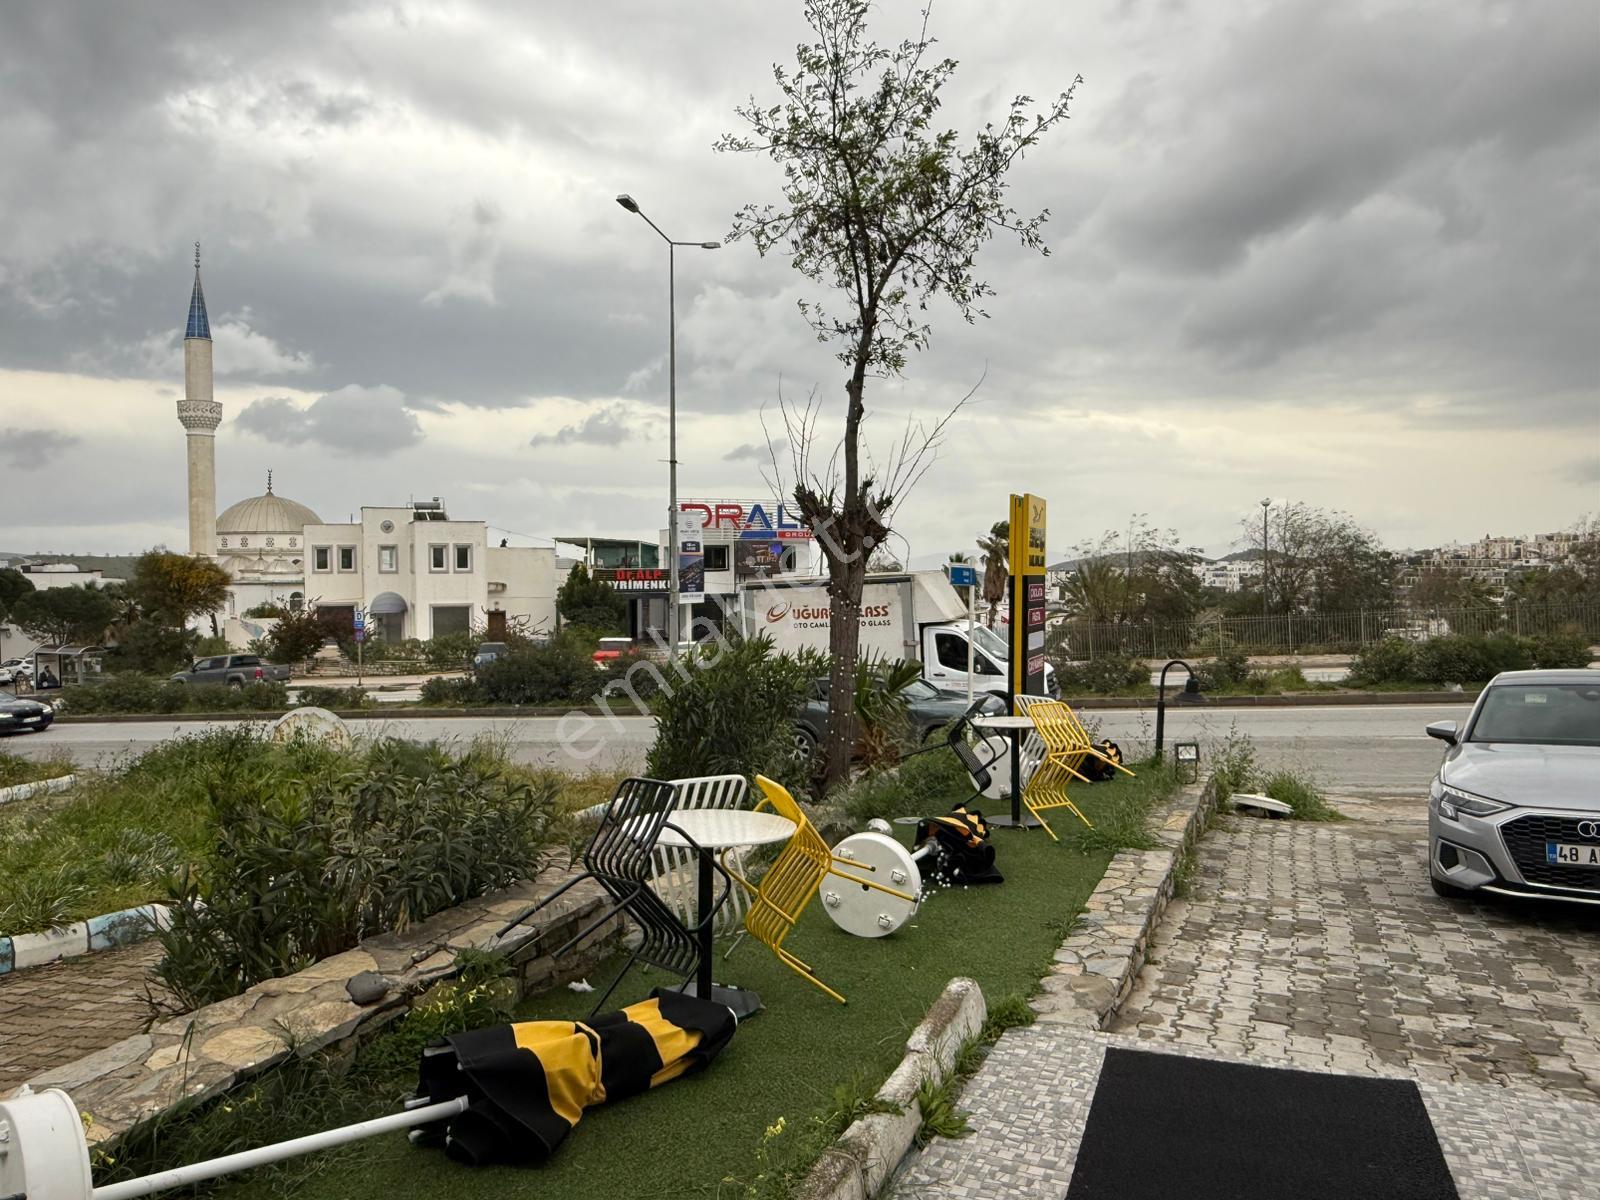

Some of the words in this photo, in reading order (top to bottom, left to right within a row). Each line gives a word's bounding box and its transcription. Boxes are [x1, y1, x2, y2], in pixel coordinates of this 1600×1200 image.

[681, 503, 806, 529] DRAL
[793, 603, 831, 620] UĞUR
[868, 619, 891, 627] GLASS
[1558, 846, 1579, 862] 48
[1589, 848, 1600, 864] A
